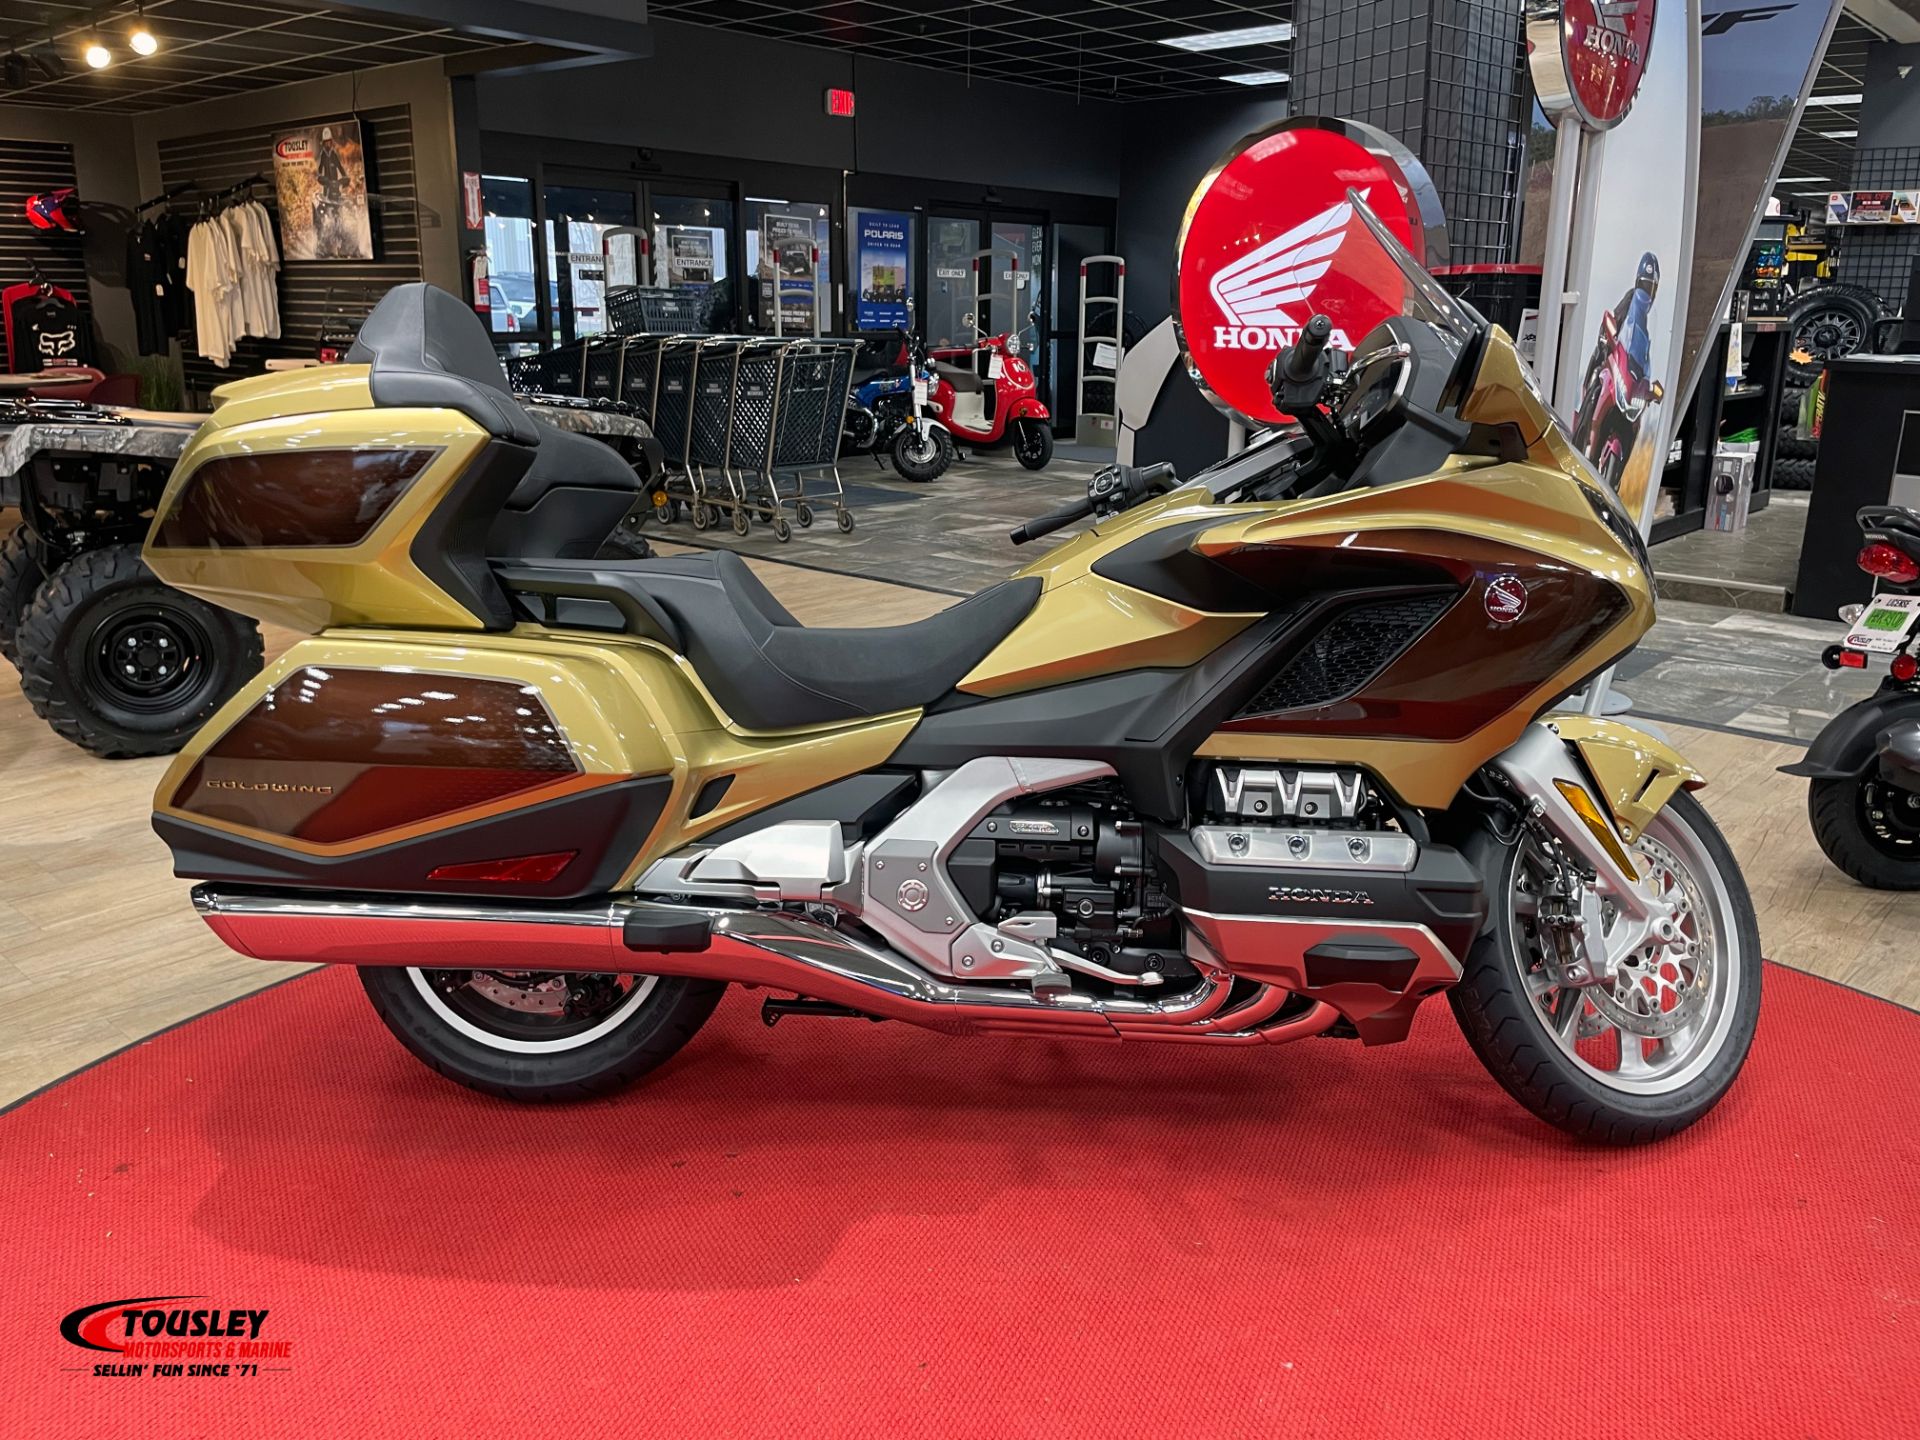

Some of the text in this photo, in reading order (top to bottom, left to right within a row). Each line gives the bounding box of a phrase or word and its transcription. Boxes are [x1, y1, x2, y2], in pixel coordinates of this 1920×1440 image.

[1583, 25, 1640, 64] HONDA
[832, 90, 852, 114] EXIT
[284, 140, 308, 153] TOUSLEY
[864, 229, 904, 240] POLARIS
[570, 254, 604, 263] ENTRAN
[676, 258, 713, 267] ENTRANCE
[1213, 326, 1357, 352] HONA
[1490, 605, 1519, 614] HONDA
[1886, 598, 1912, 608] LICENSE
[206, 780, 334, 794] GOLDWING
[1268, 885, 1375, 904] HONDA
